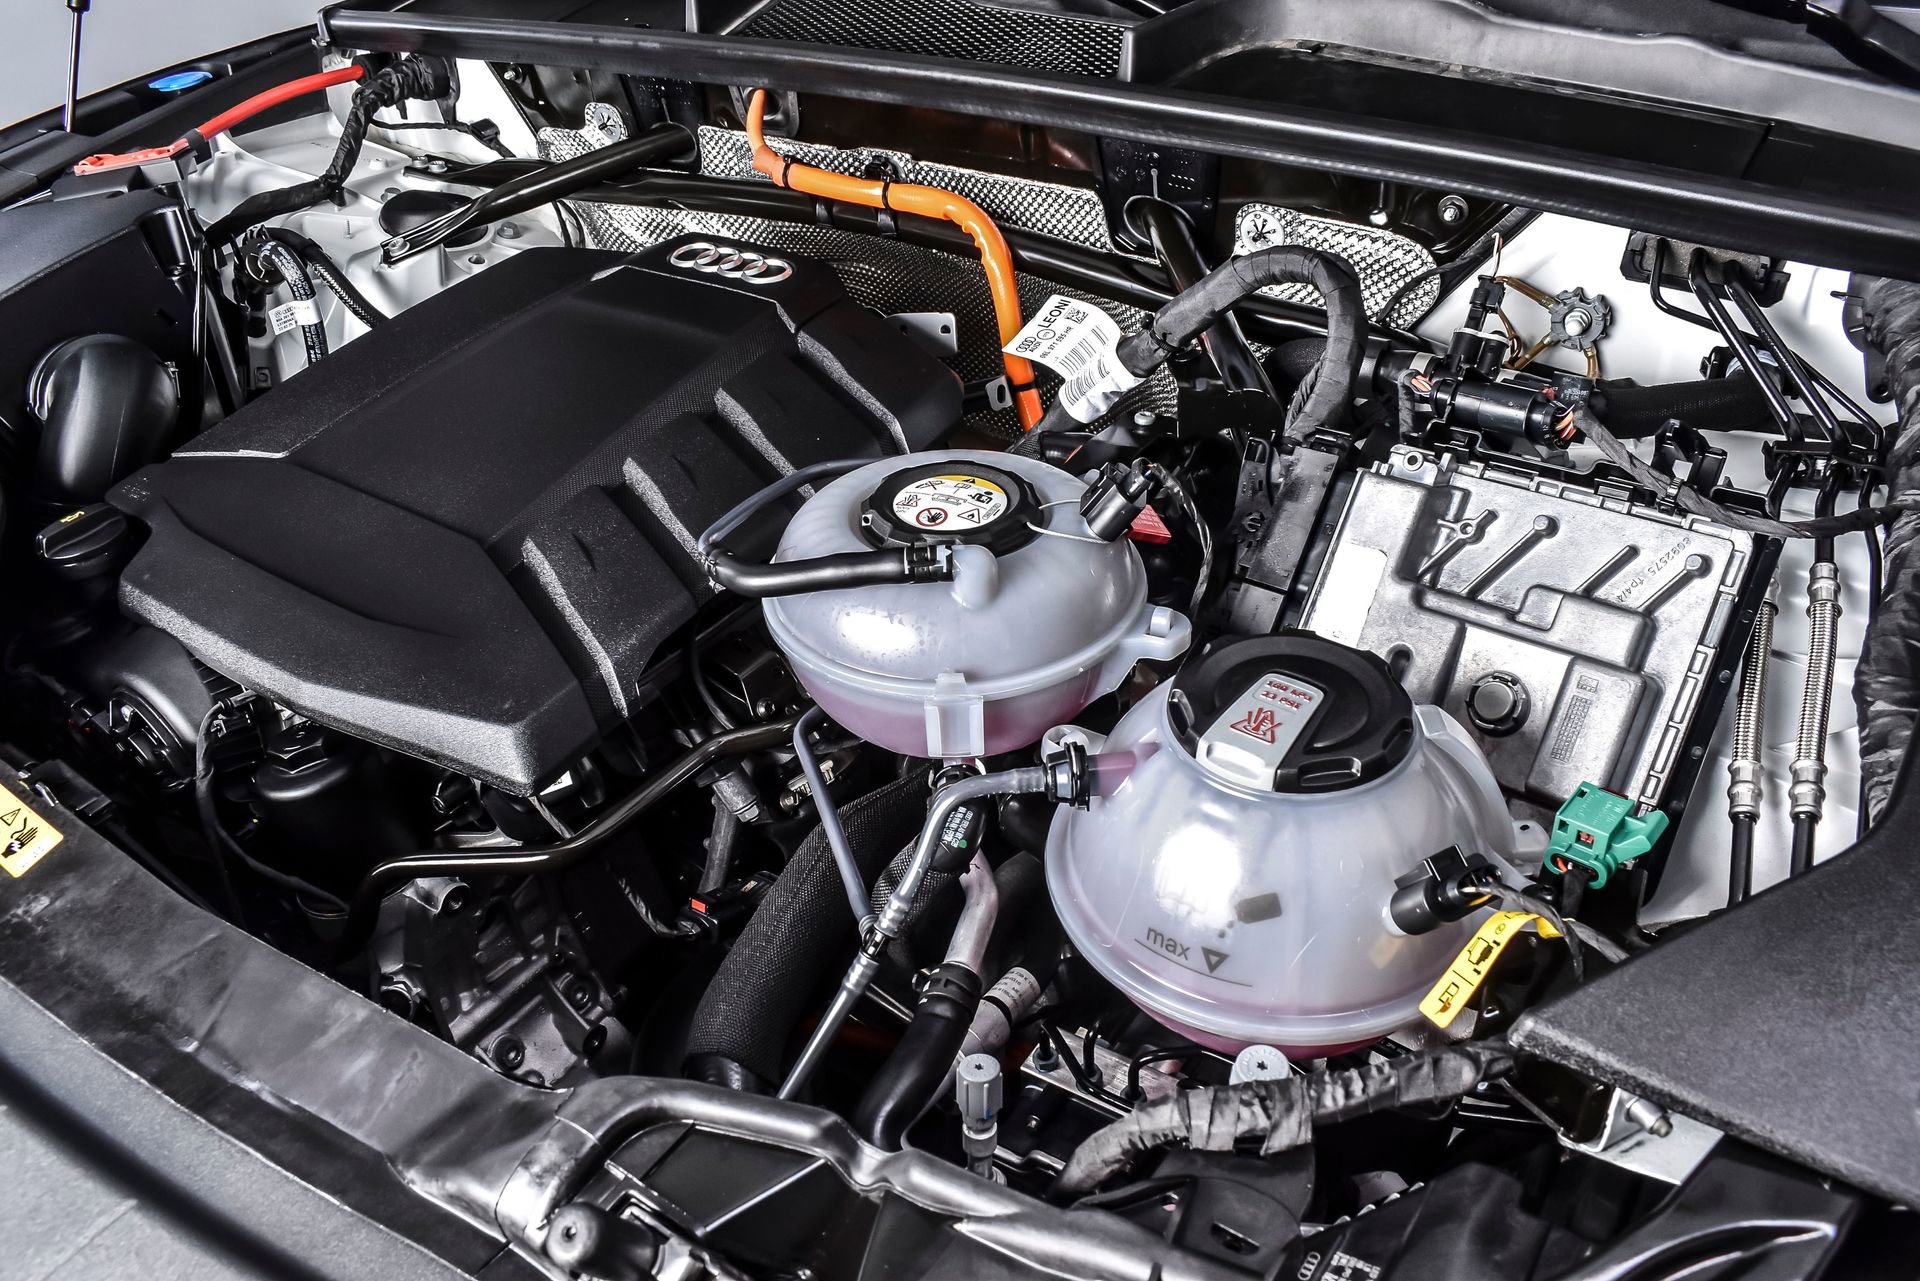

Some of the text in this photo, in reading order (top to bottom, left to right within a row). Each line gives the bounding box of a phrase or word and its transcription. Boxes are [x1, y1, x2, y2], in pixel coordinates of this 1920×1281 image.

[1038, 299, 1071, 328] LEONI
[1029, 341, 1042, 352] AUDI
[1260, 690, 1302, 711] 23 PSI
[1266, 680, 1313, 702] 160 kPa
[1146, 927, 1191, 961] max
